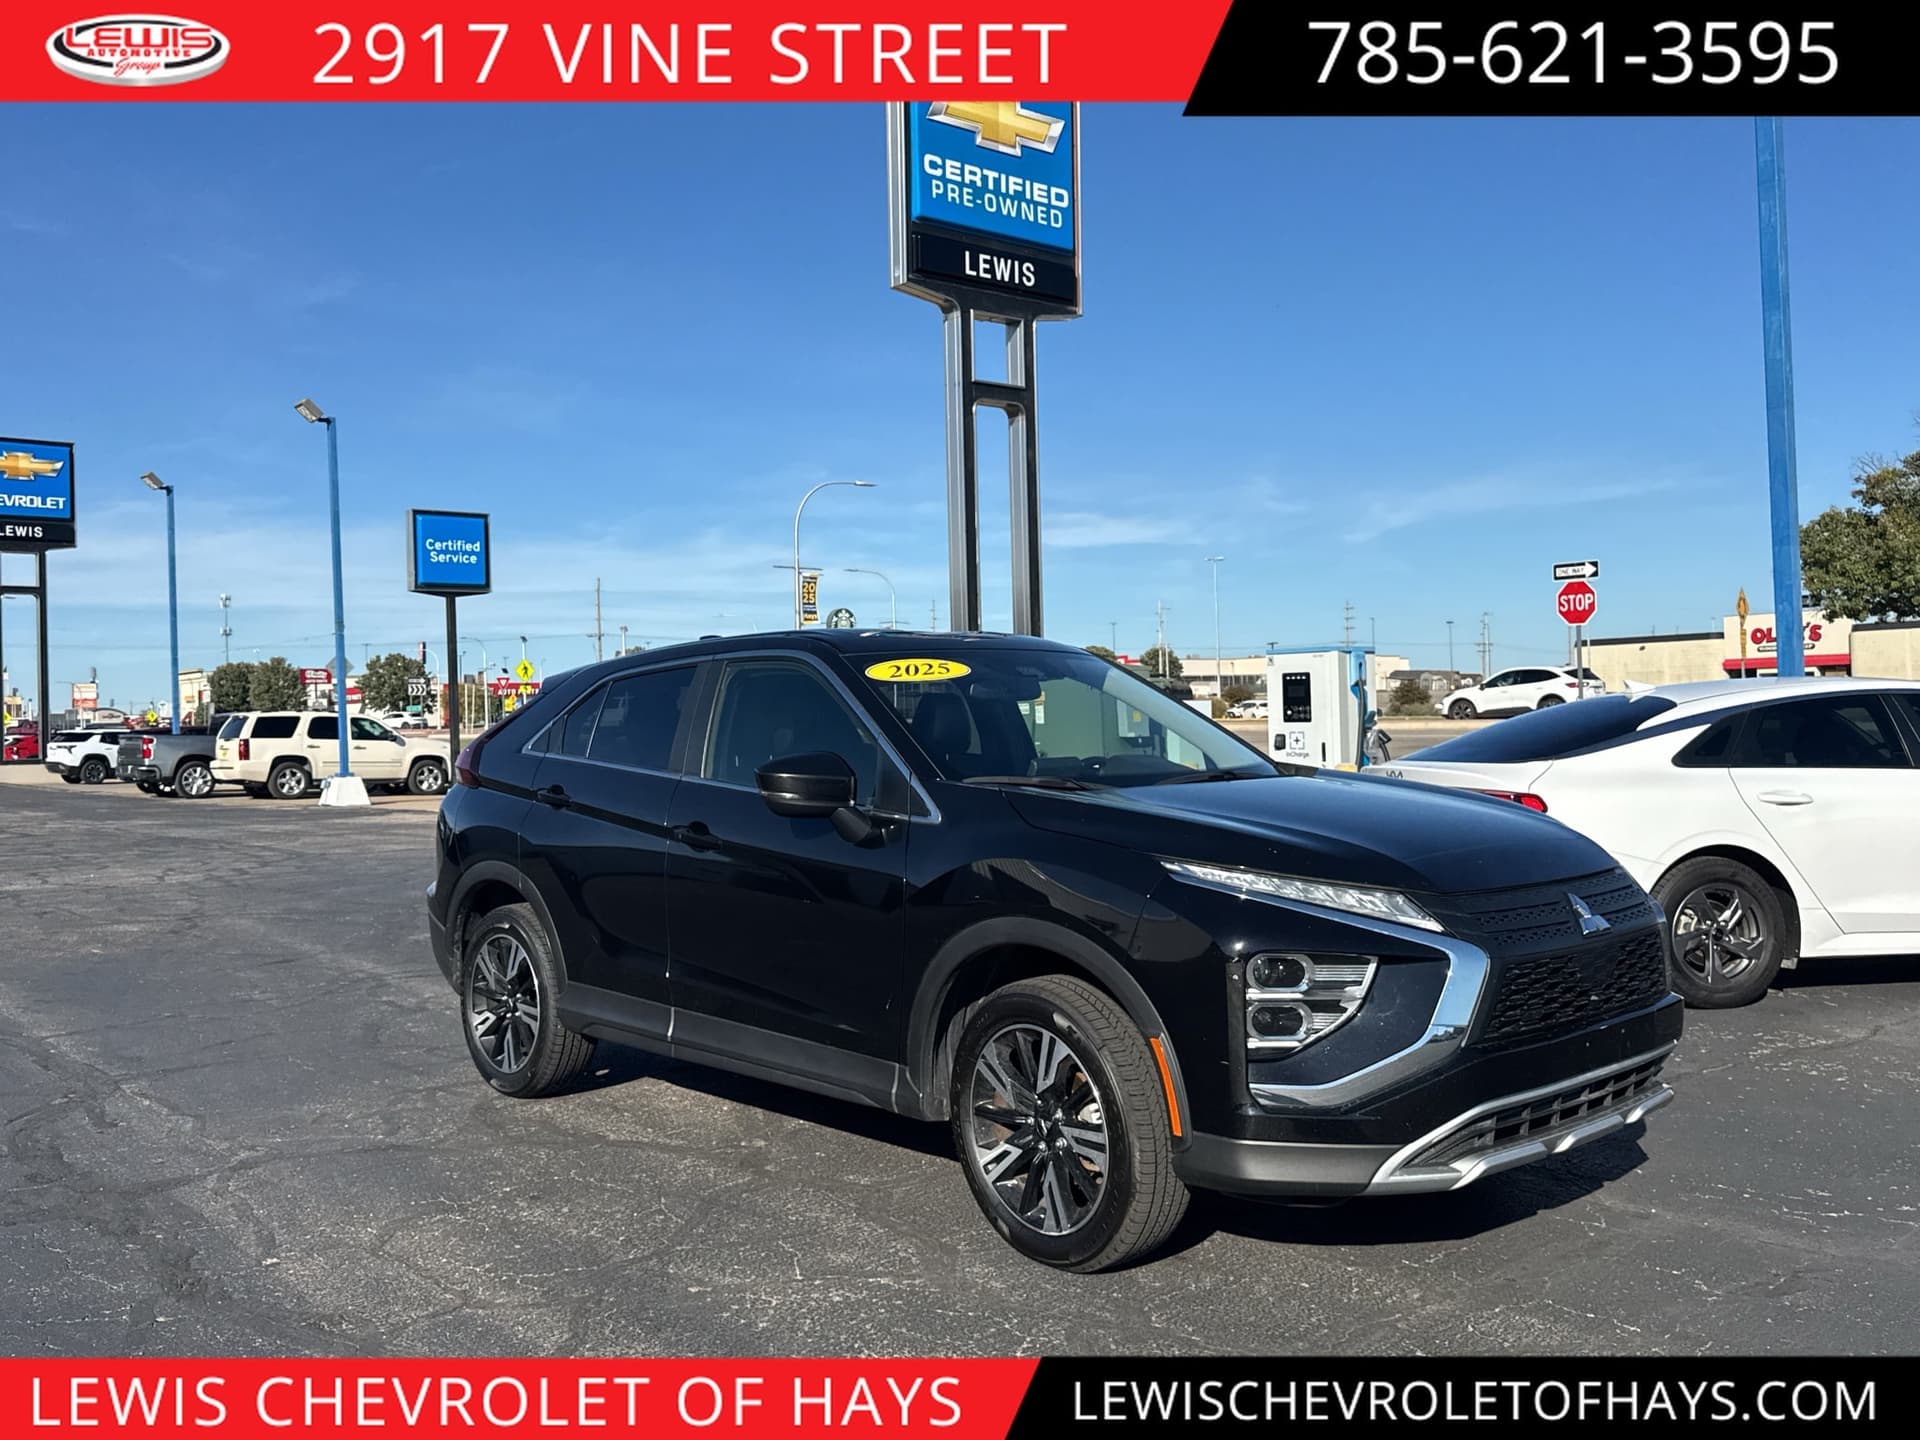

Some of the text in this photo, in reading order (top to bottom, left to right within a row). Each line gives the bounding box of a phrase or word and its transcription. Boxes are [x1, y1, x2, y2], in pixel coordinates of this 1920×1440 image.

[923, 153, 1069, 209] CERTIFIED
[931, 180, 1064, 229] PRE-OWNED
[964, 250, 1036, 287] LEWIS
[425, 538, 481, 552] Certified
[430, 551, 478, 564] Service
[802, 582, 816, 593] 20
[802, 593, 816, 603] 25
[1559, 593, 1594, 612] STOP
[888, 662, 951, 679] 2025
